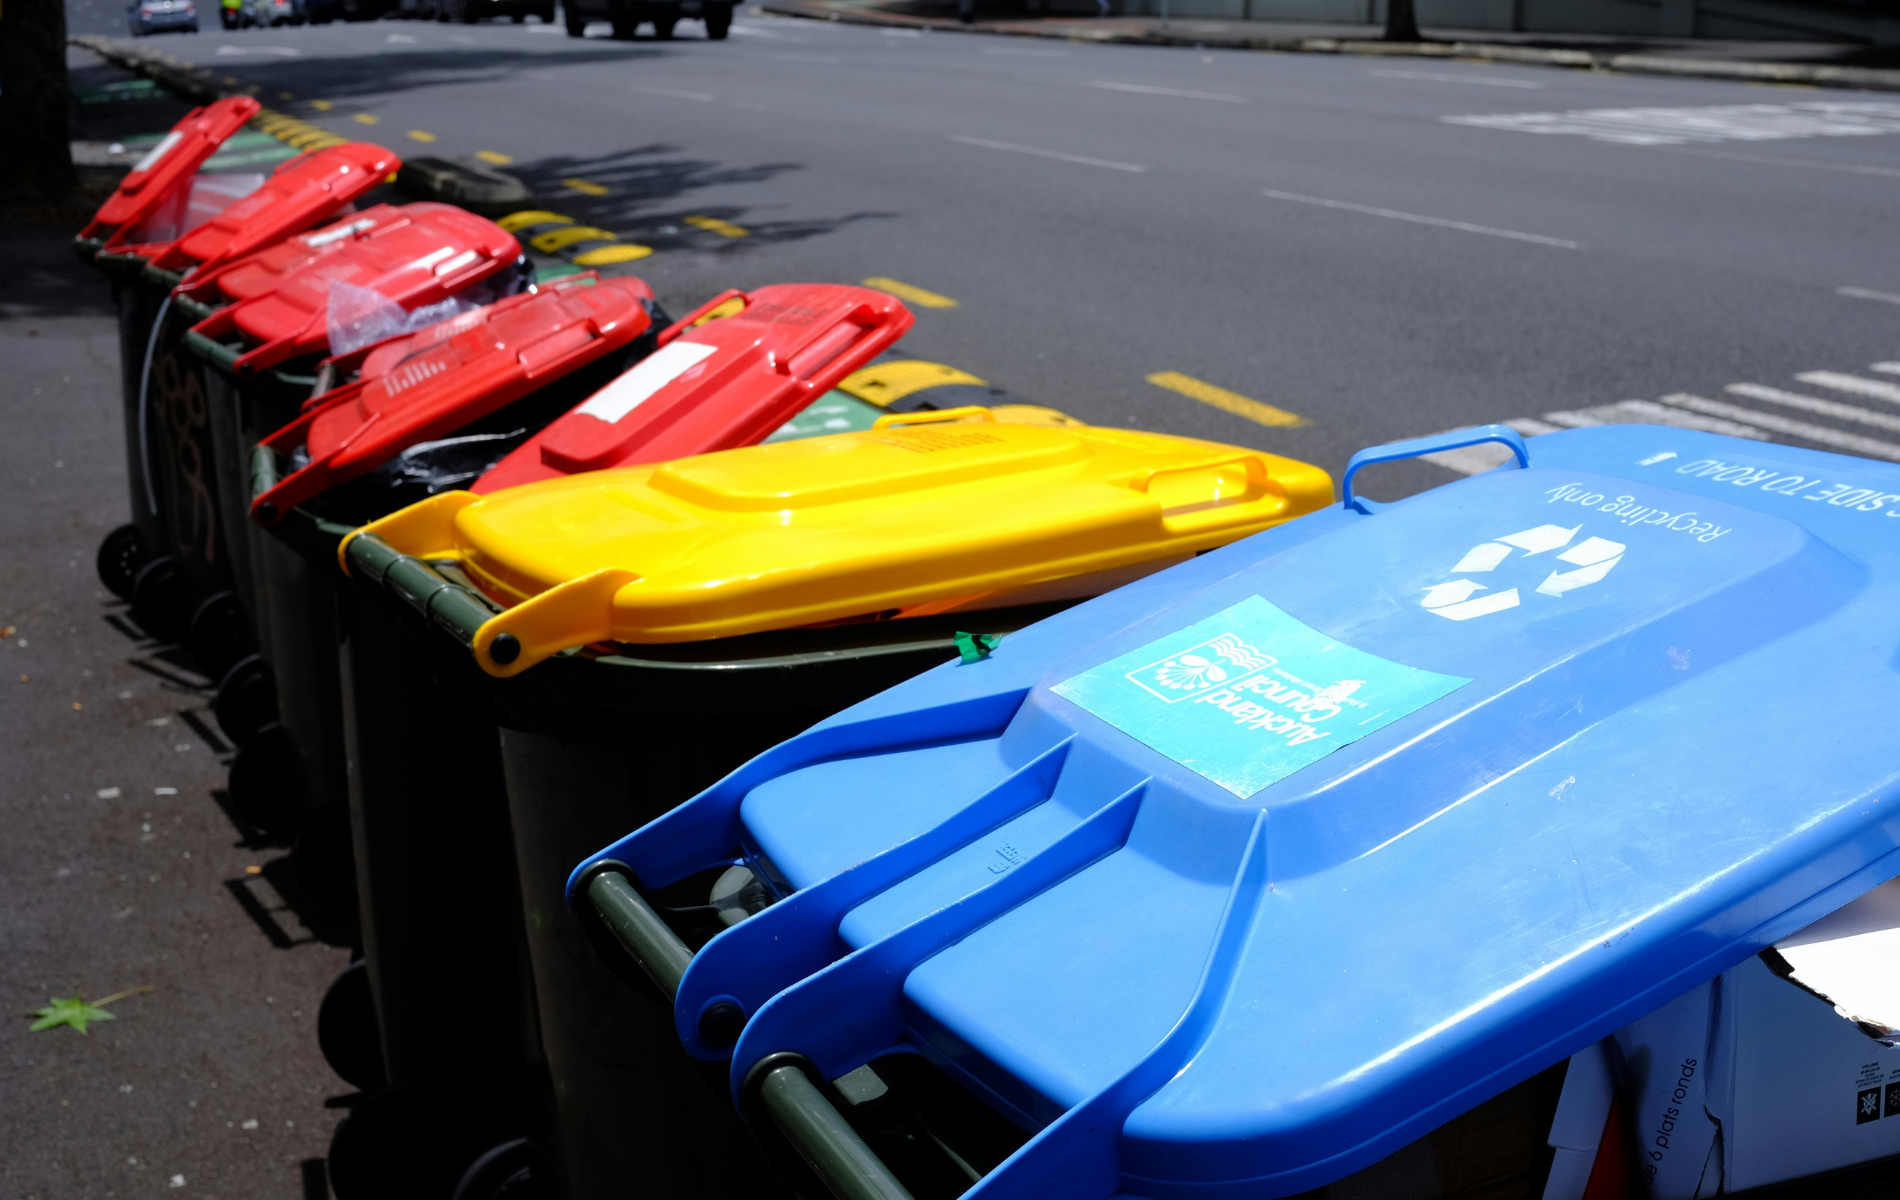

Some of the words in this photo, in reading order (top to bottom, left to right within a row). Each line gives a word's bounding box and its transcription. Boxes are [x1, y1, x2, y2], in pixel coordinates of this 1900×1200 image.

[1675, 459, 1779, 487] ROAD
[1760, 475, 1822, 496] TO
[1545, 482, 1605, 506] only
[1803, 483, 1884, 512] SIDE
[1596, 495, 1732, 543] Recycling
[1230, 674, 1342, 723] Council
[1193, 688, 1332, 747] Auckland
[1671, 1057, 1698, 1105] ronds
[1655, 1107, 1680, 1149] plats
[1648, 1150, 1663, 1162] 6
[1643, 1163, 1658, 1186] de
